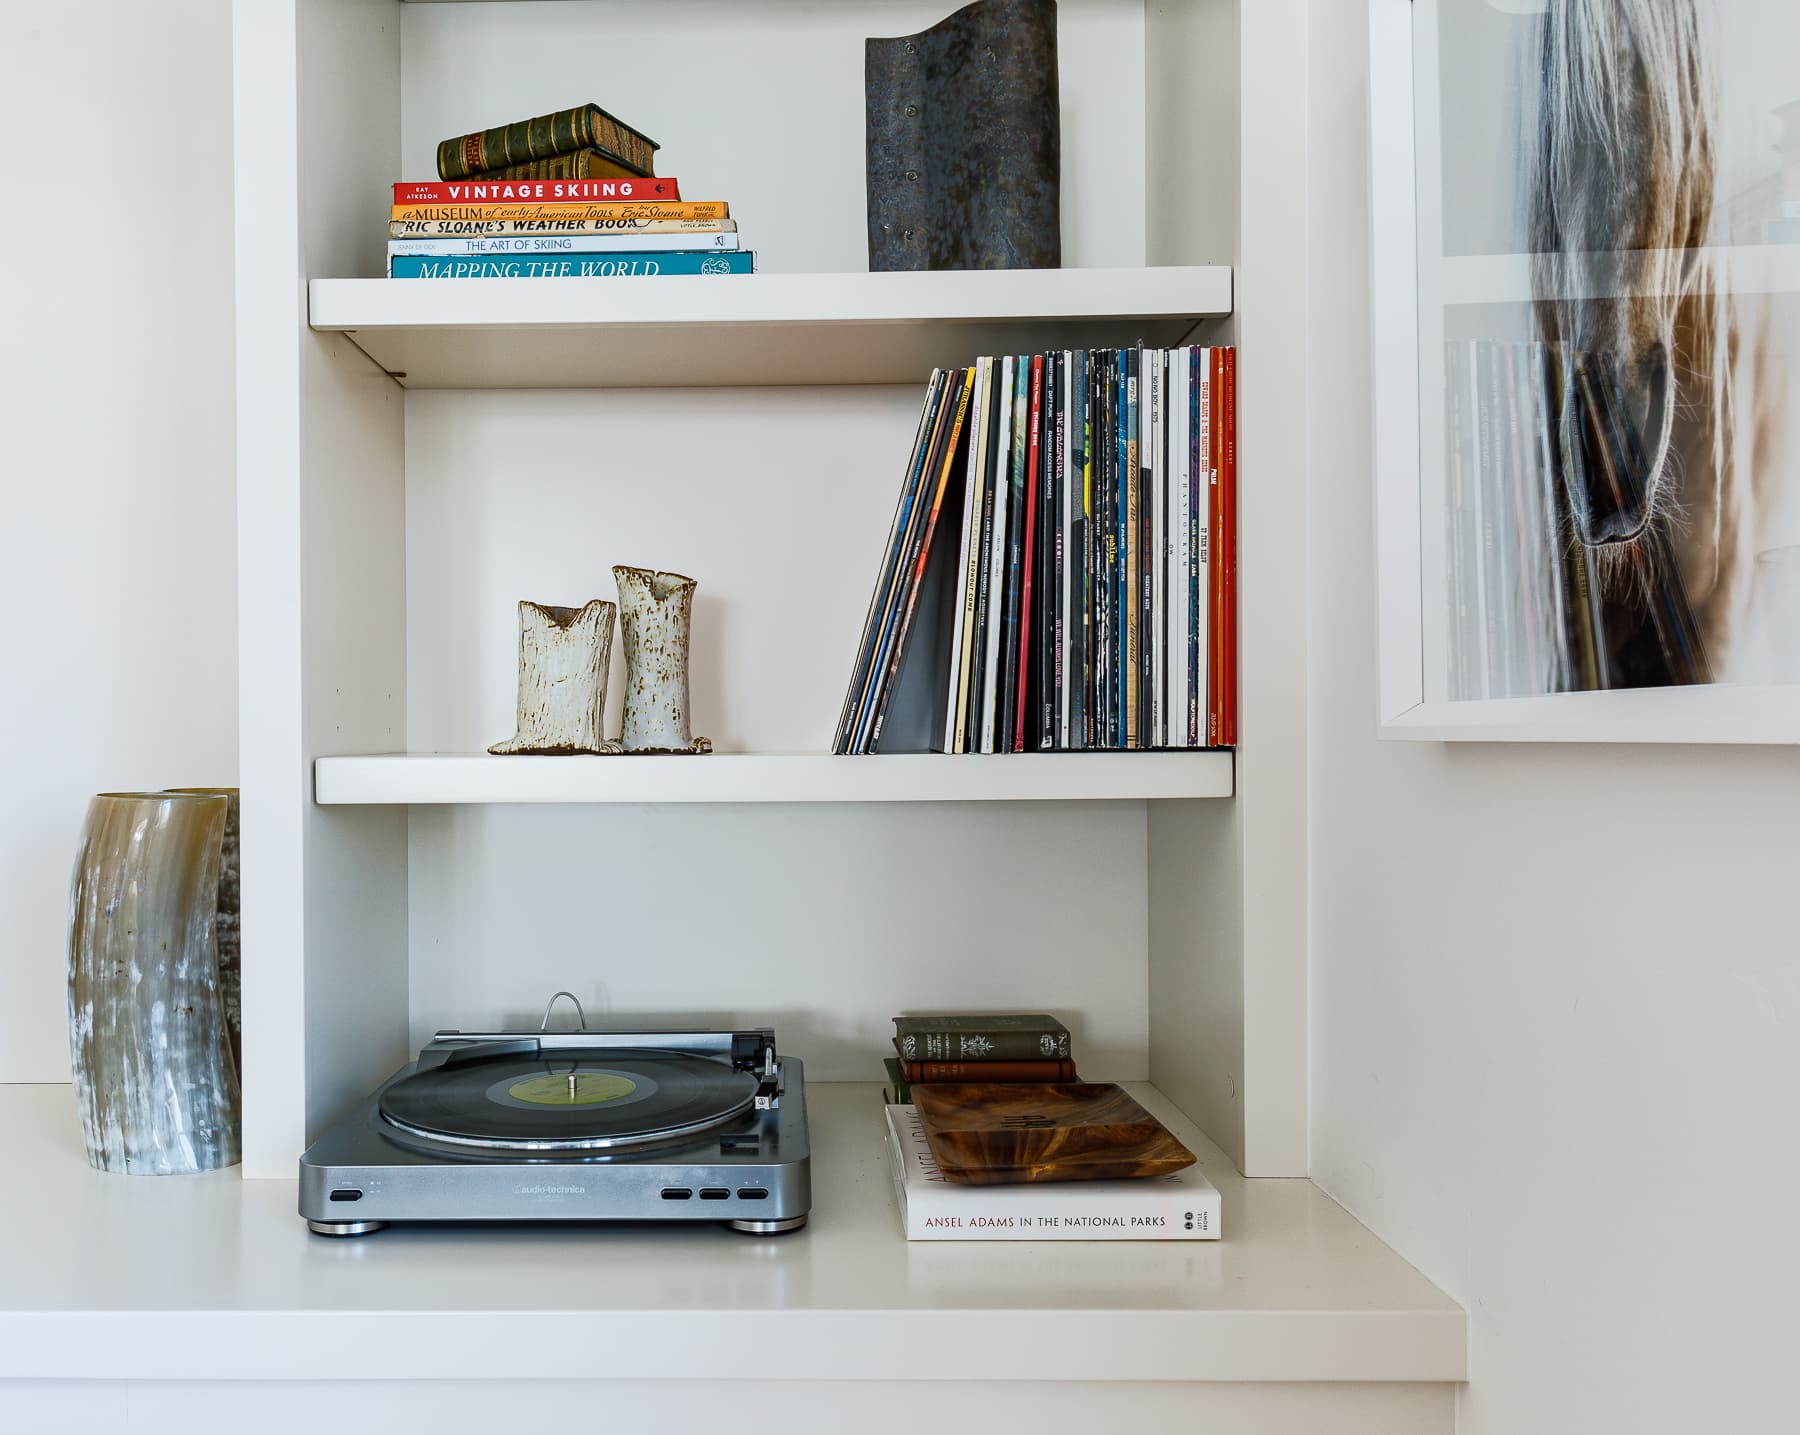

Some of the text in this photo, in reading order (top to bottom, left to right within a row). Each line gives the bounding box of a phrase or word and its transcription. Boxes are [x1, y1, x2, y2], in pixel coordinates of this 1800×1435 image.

[448, 181, 633, 199] VINTAGE SKIING
[415, 207, 483, 220] MUSEUM
[485, 207, 502, 219] of
[500, 206, 531, 219] early
[528, 205, 584, 219] American
[644, 205, 685, 218] Sloane
[513, 219, 586, 231] WEATHER
[466, 238, 572, 250] THE ART OF SKIING
[419, 261, 660, 278] MAPPING THE WORLD
[969, 559, 977, 591] BLOWOUT
[1055, 619, 1062, 629] WE
[1129, 613, 1138, 665] Funeral
[520, 1184, 585, 1193] audio-technica
[925, 1216, 1166, 1227] ANSEL ADAMS IN THE NATIONAL PARKS
